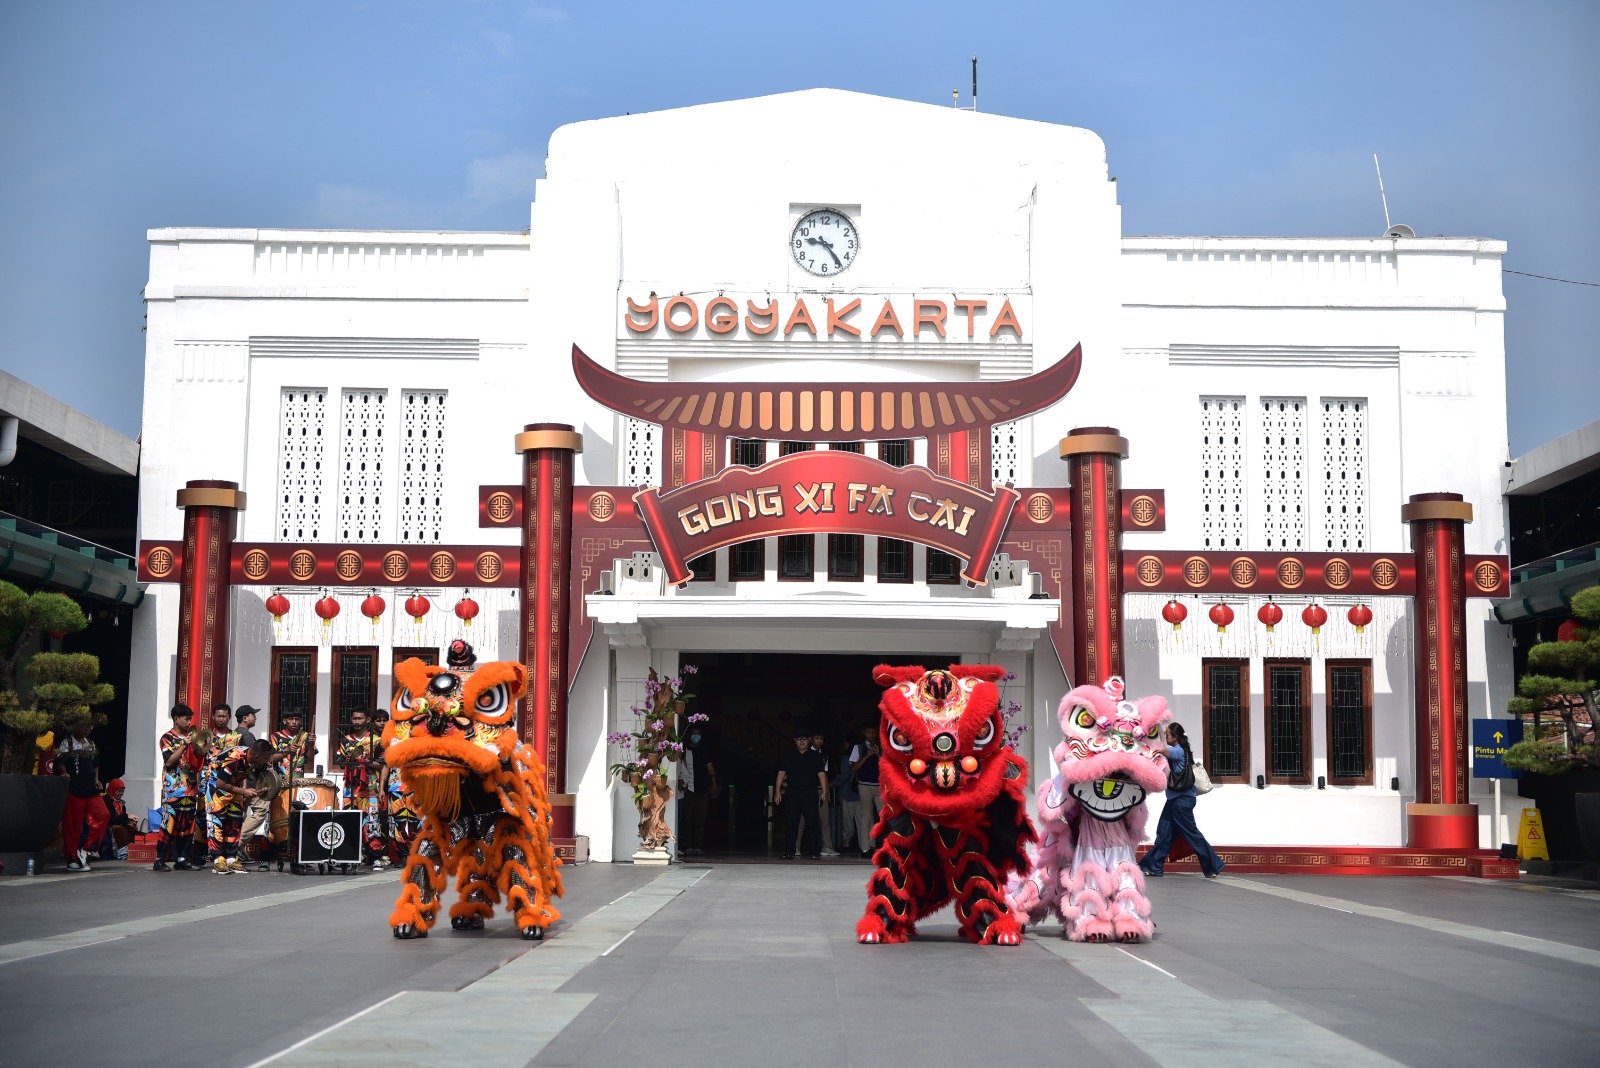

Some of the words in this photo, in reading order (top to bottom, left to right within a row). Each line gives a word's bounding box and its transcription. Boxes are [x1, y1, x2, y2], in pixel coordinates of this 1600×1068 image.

[807, 218, 816, 228] 11
[820, 216, 830, 226] 12
[799, 228, 809, 236] 10
[844, 228, 850, 237] 2
[796, 240, 802, 248] 9
[848, 240, 854, 248] 3
[800, 251, 806, 260] 8
[844, 252, 850, 260] 4
[808, 260, 814, 268] 7
[822, 264, 828, 272] 6
[834, 260, 840, 269] 5
[625, 294, 1023, 337] YOGYAKARTA
[677, 484, 784, 537] GONG
[794, 481, 835, 514] XI
[848, 482, 896, 516] FA
[907, 490, 978, 537] CAI
